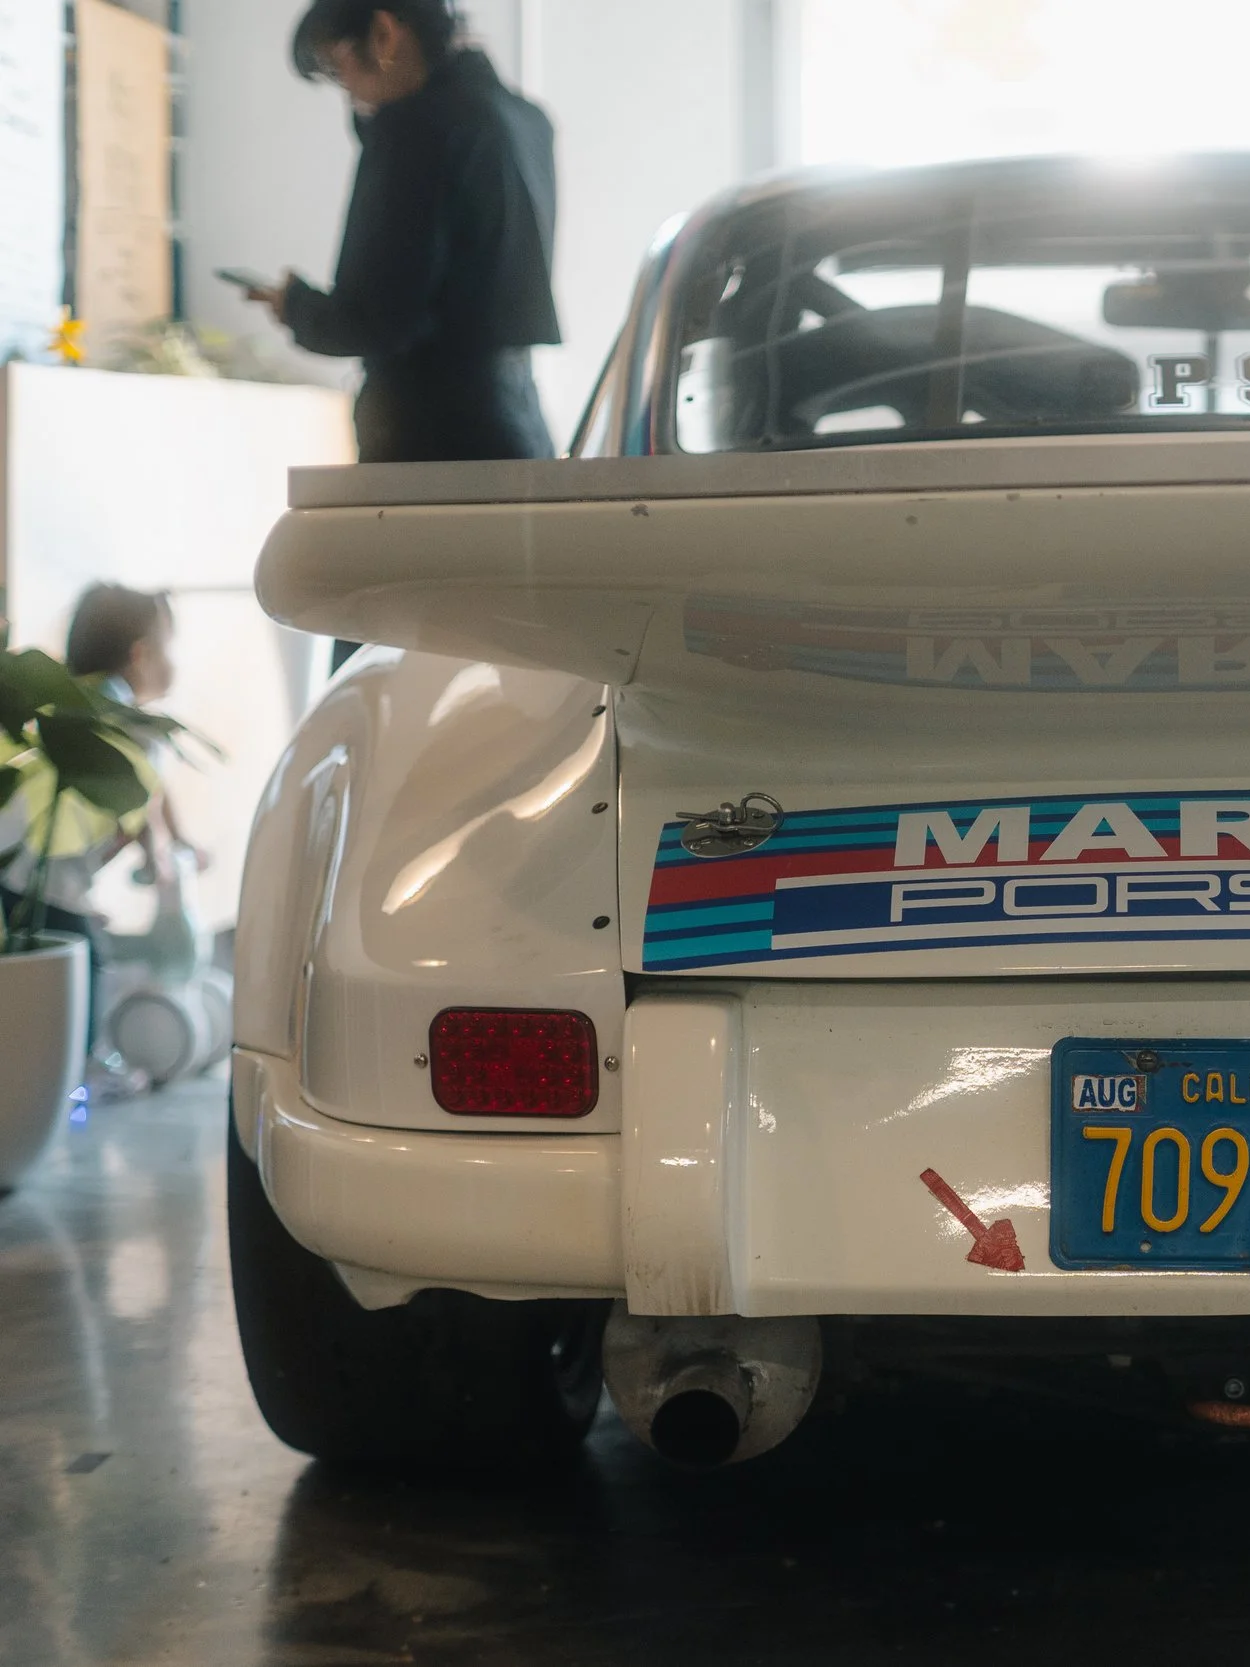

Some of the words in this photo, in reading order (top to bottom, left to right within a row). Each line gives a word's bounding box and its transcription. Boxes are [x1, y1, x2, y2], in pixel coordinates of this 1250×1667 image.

[1148, 352, 1210, 407] P
[1079, 1078, 1136, 1107] AUG
[1083, 1127, 1250, 1233] 709
